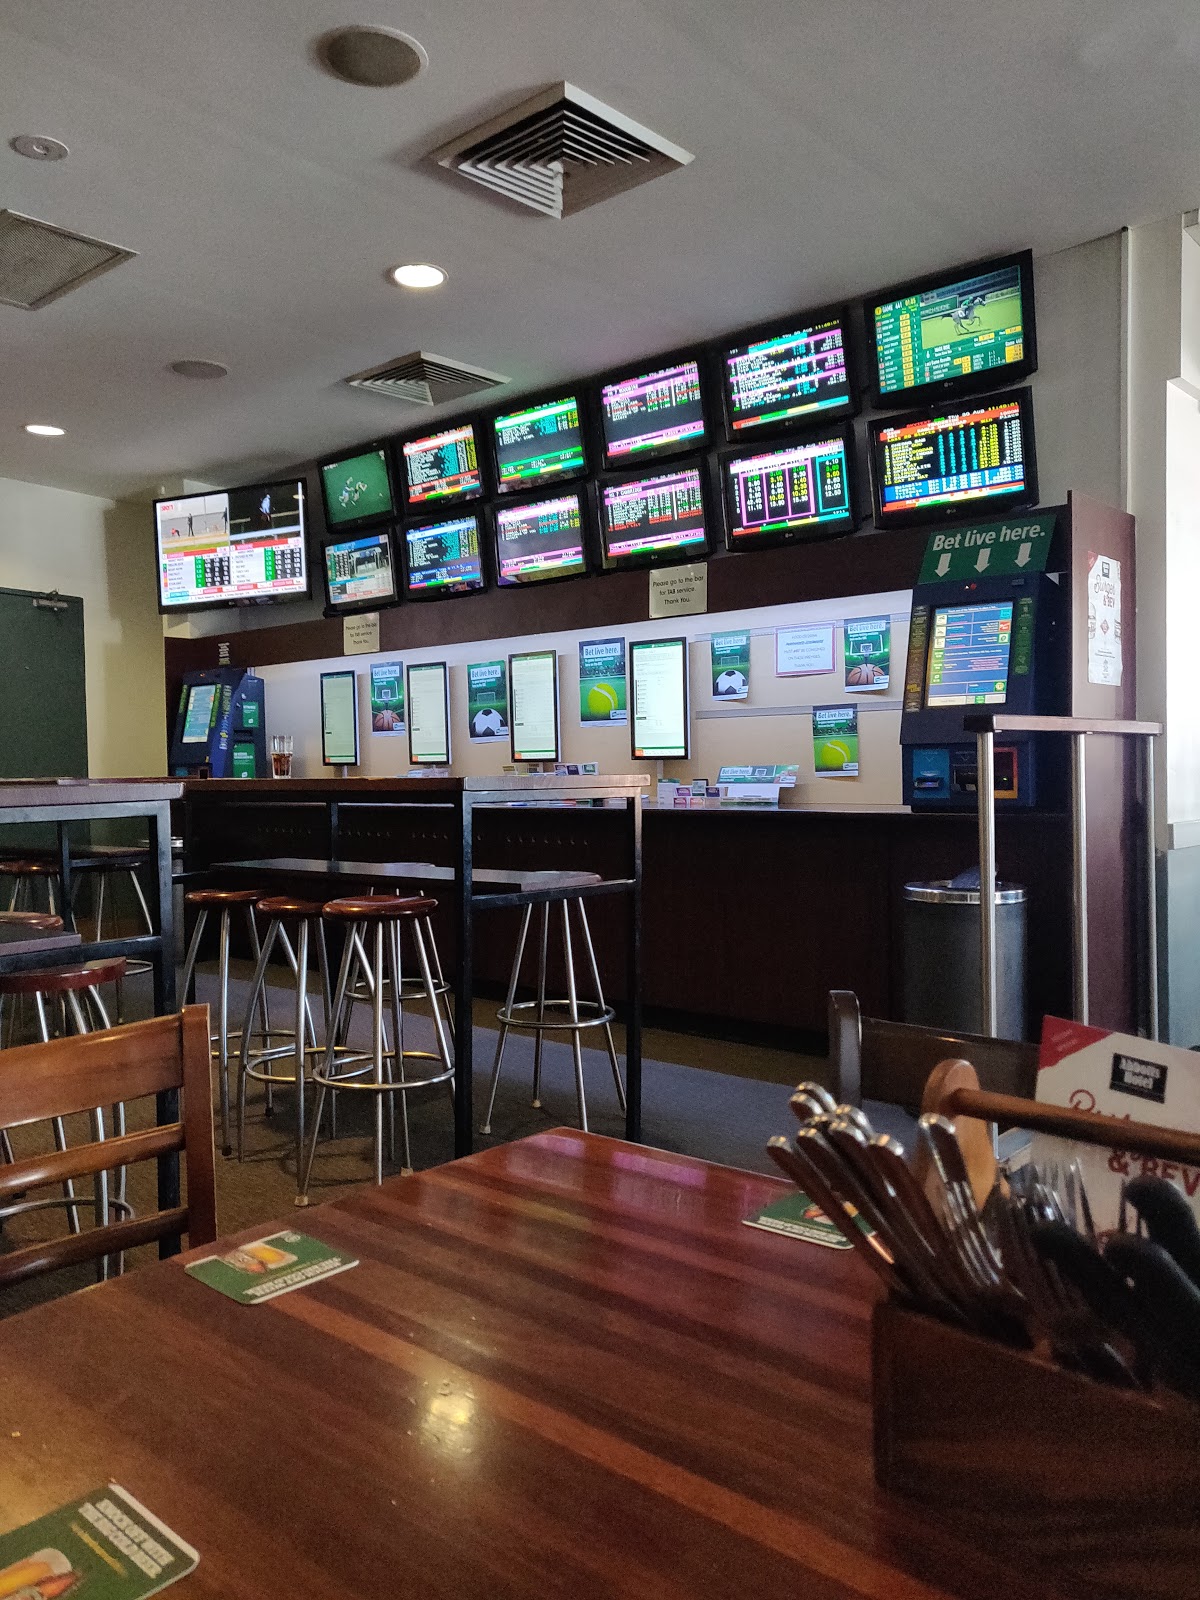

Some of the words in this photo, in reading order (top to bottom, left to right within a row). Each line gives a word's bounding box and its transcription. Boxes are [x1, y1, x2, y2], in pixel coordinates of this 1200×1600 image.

[932, 534, 962, 551] Bet
[964, 530, 996, 547] live
[1000, 524, 1046, 542] here.
[652, 580, 668, 588] Please
[585, 648, 594, 656] Bet
[605, 646, 618, 654] here.
